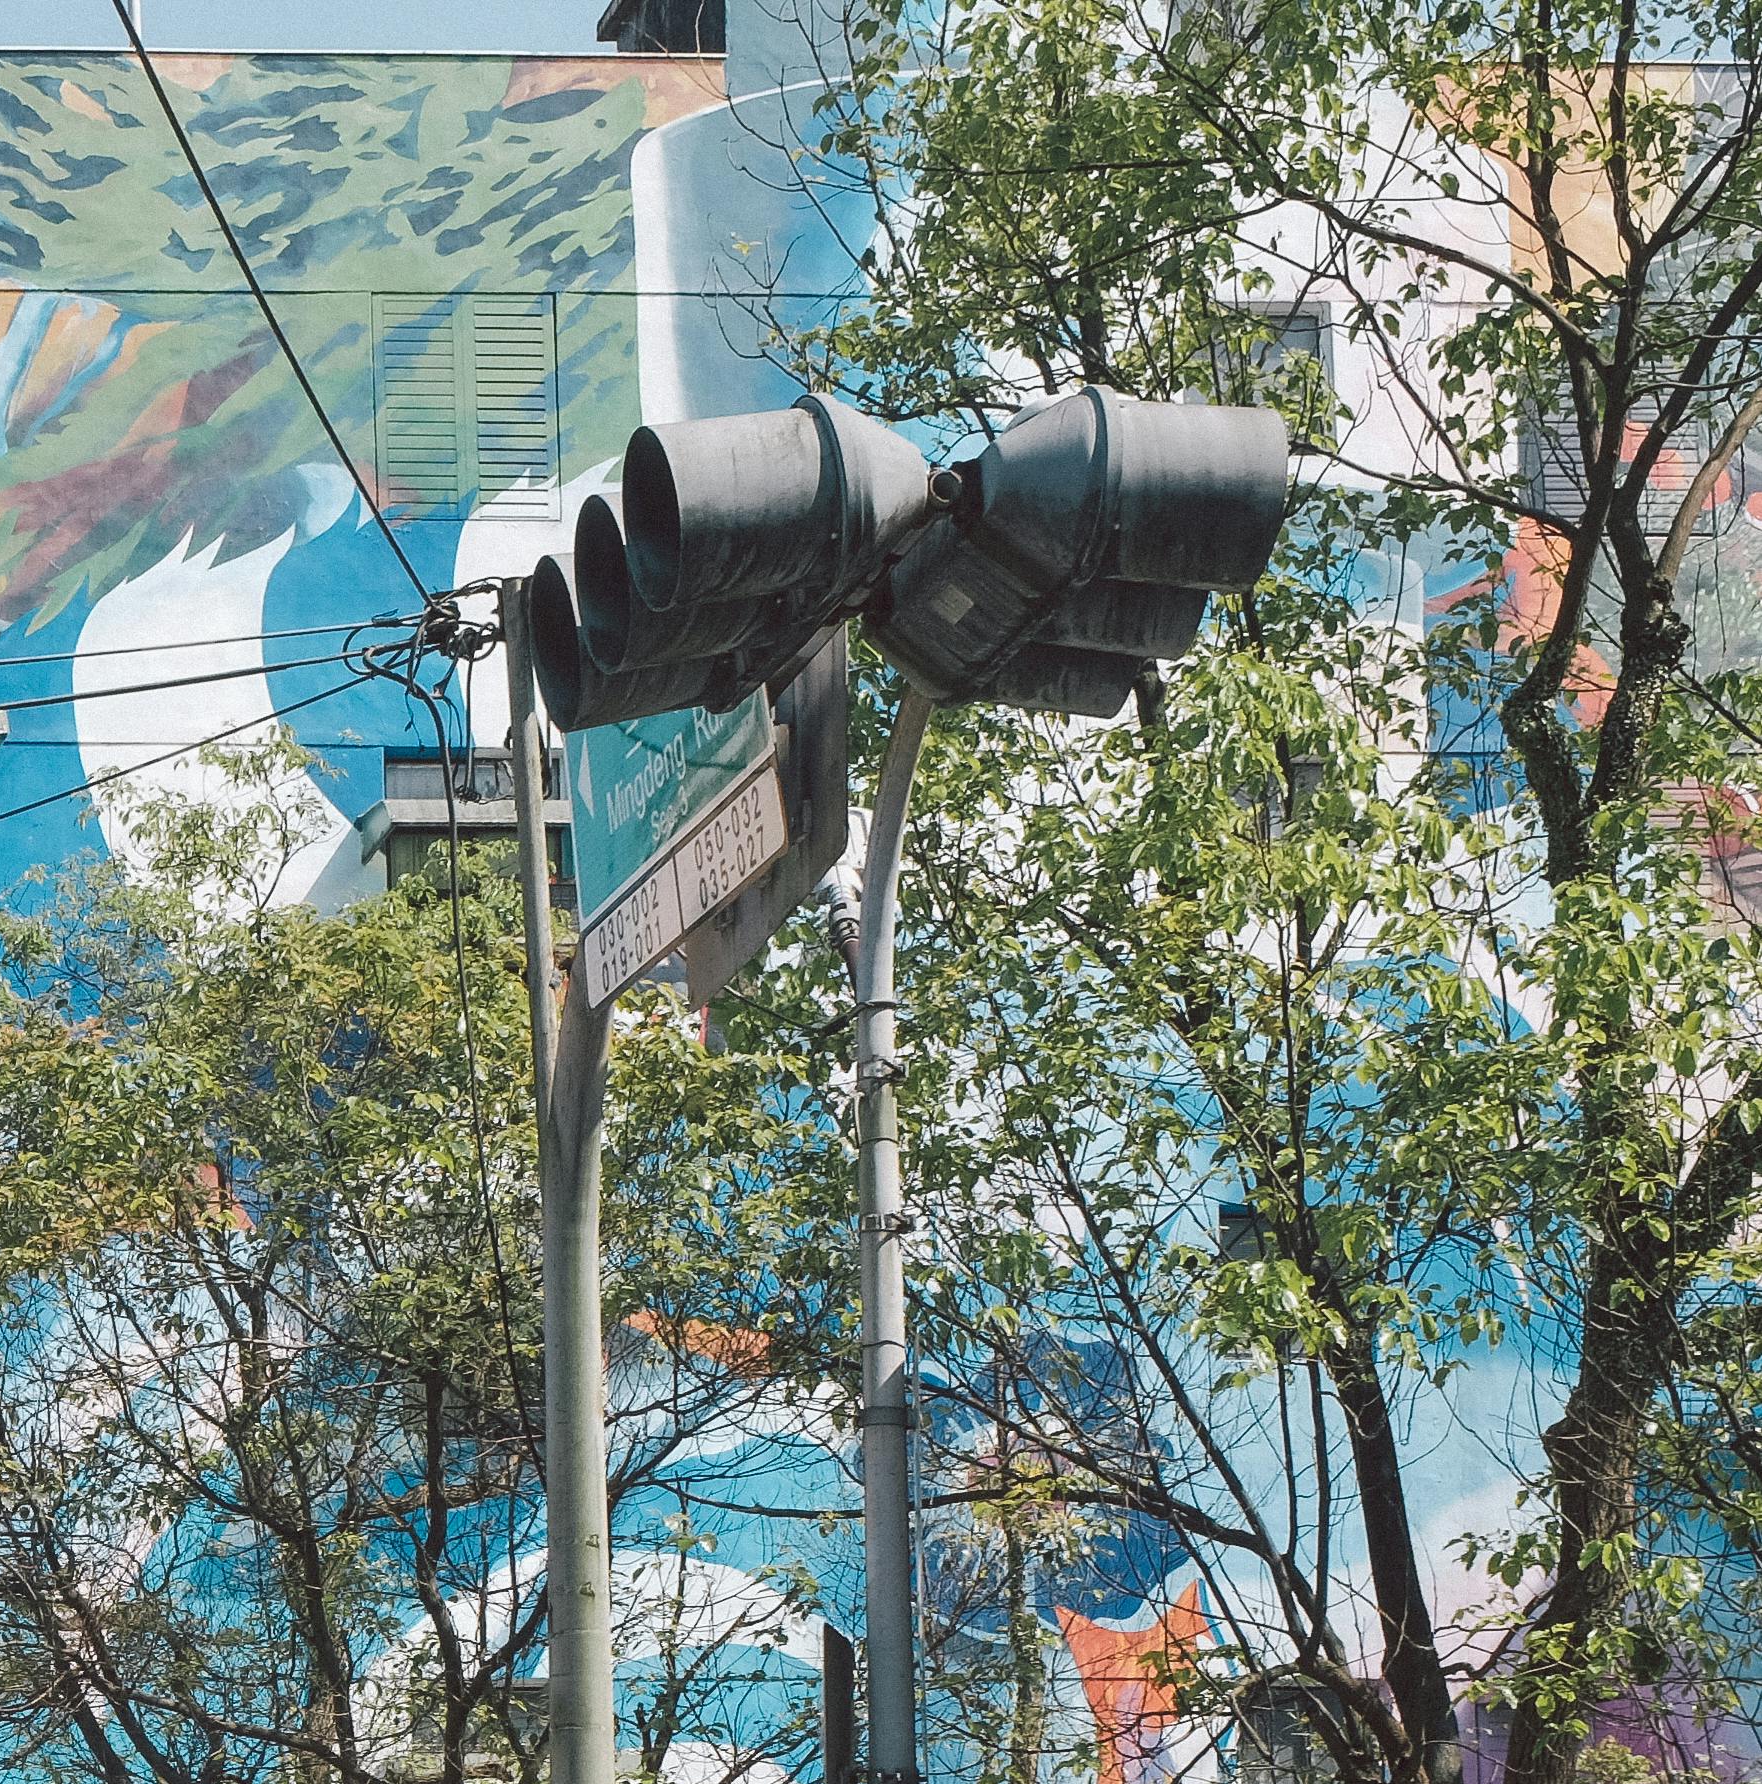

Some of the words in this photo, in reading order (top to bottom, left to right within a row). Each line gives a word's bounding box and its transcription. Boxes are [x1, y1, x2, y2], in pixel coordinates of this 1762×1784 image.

[606, 731, 687, 836] Mingdeng
[693, 785, 762, 872] 050-032
[698, 825, 765, 910] 035-027
[598, 878, 659, 956] 030-002
[601, 920, 663, 993] 019-001
